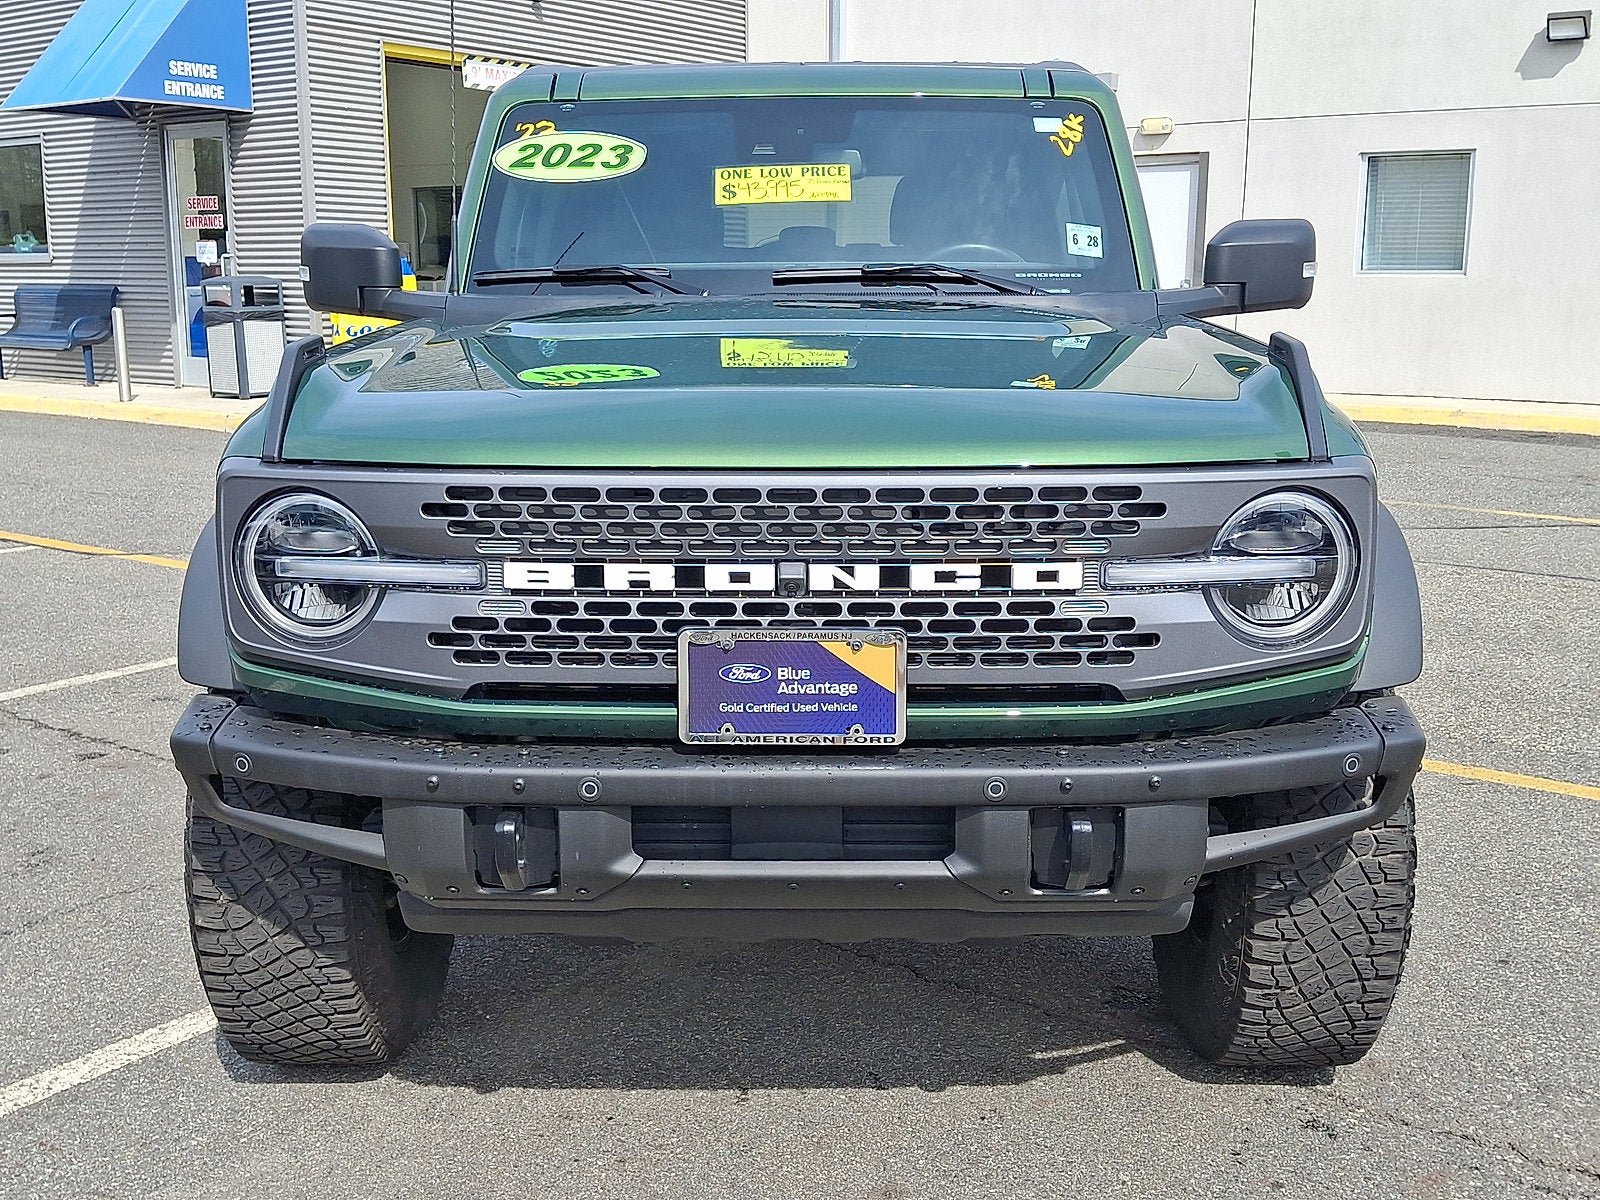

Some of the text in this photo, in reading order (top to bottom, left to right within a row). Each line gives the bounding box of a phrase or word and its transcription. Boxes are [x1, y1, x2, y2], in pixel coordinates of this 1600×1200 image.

[168, 60, 218, 79] SERVICE
[164, 80, 225, 100] ENTRANCE
[509, 143, 634, 169] 2023
[720, 166, 846, 180] ONE LOW PRICE
[187, 196, 218, 210] SERVICE
[185, 215, 223, 228] ENTRANCE
[1072, 234, 1099, 247] 6 28
[503, 563, 1083, 591] BRONCO
[727, 666, 762, 681] Ford
[777, 667, 811, 680] Blue
[777, 681, 858, 696] Advantage
[719, 702, 858, 713] Gold Certified Used Vehicle
[731, 735, 835, 744] AMERICAN
[843, 735, 896, 744] FORD
